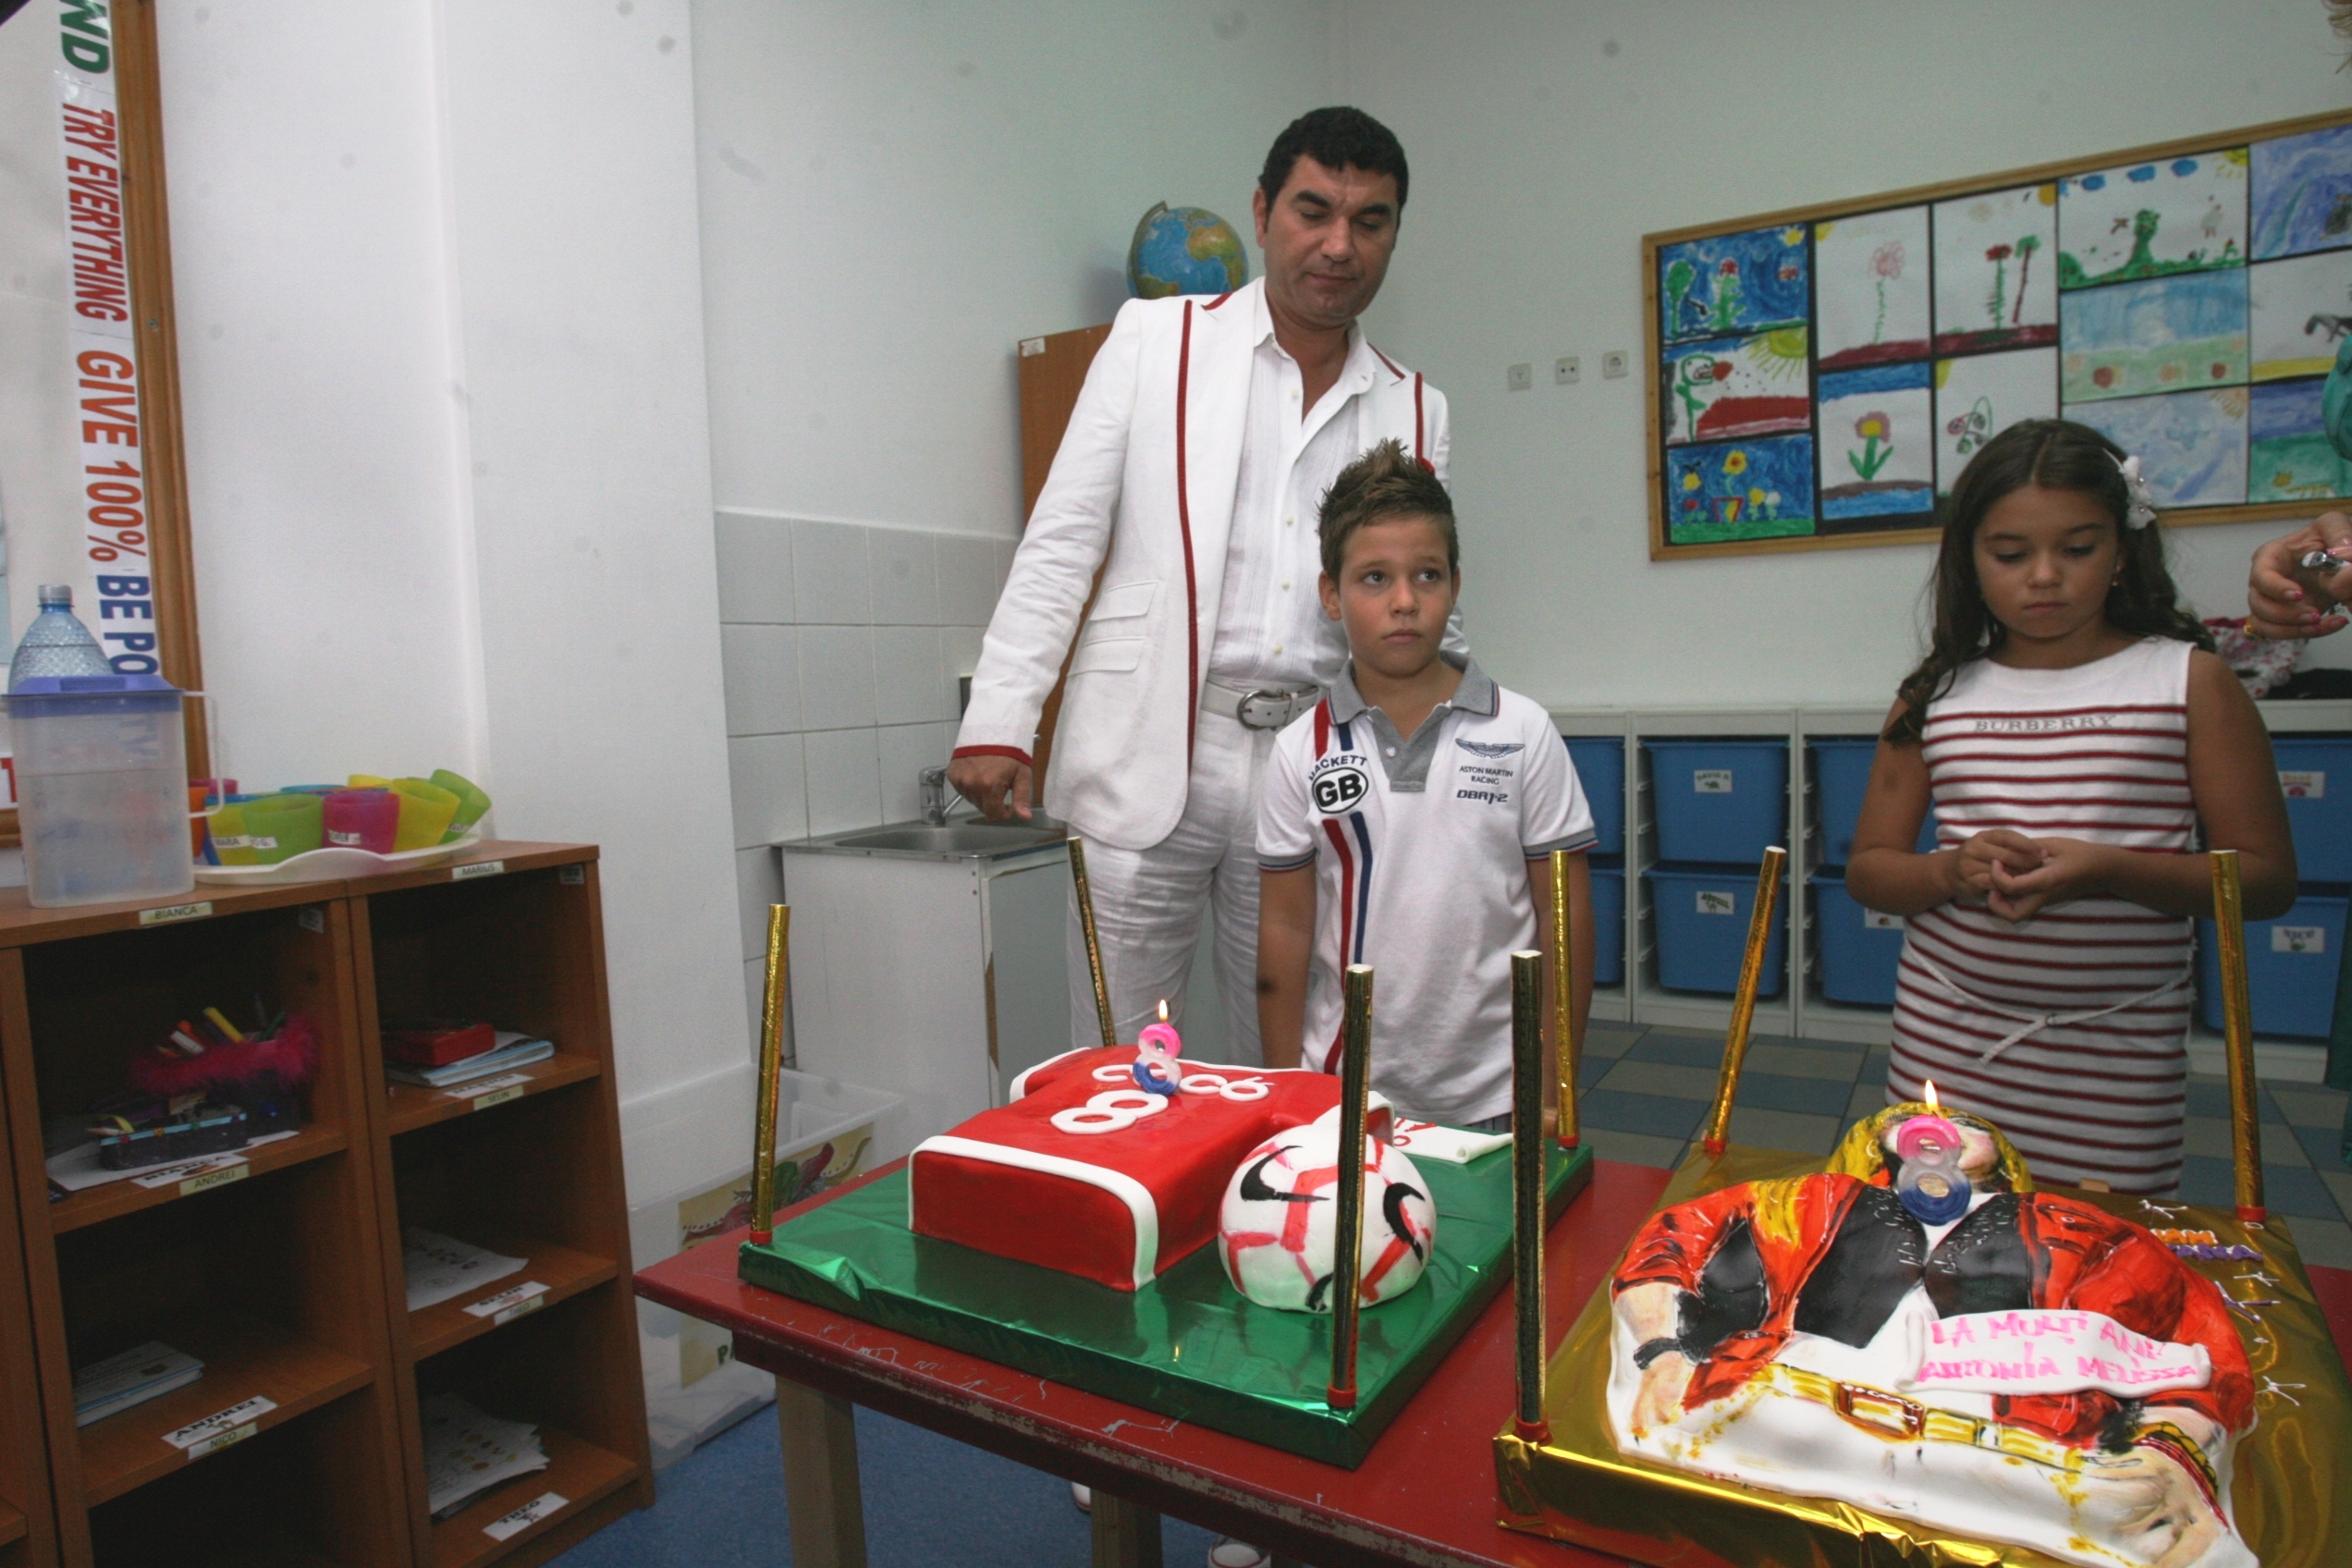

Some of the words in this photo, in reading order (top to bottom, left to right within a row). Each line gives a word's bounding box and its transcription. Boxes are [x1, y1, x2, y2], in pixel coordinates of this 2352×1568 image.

[62, 103, 117, 160] TRY
[67, 155, 128, 323] EVERYTHING
[77, 350, 139, 447] GIVE
[85, 461, 146, 562] 100%
[97, 575, 153, 620] BE
[1974, 715, 2116, 732] BURBERRY
[1459, 766, 1484, 775] ASTON
[1485, 767, 1513, 778] MARTIN
[1471, 776, 1500, 785] RACING
[1316, 773, 1363, 808] GB
[462, 864, 496, 876] MARIUS
[155, 906, 198, 920] BIANCA
[1133, 1023, 1182, 1096] 8
[194, 1170, 236, 1190] ANDREI
[1896, 1114, 1972, 1227] 8
[1930, 1317, 1976, 1348] LA
[174, 1400, 258, 1438] ANDREI
[209, 1431, 238, 1449] NICO
[498, 1500, 541, 1525] THEO
